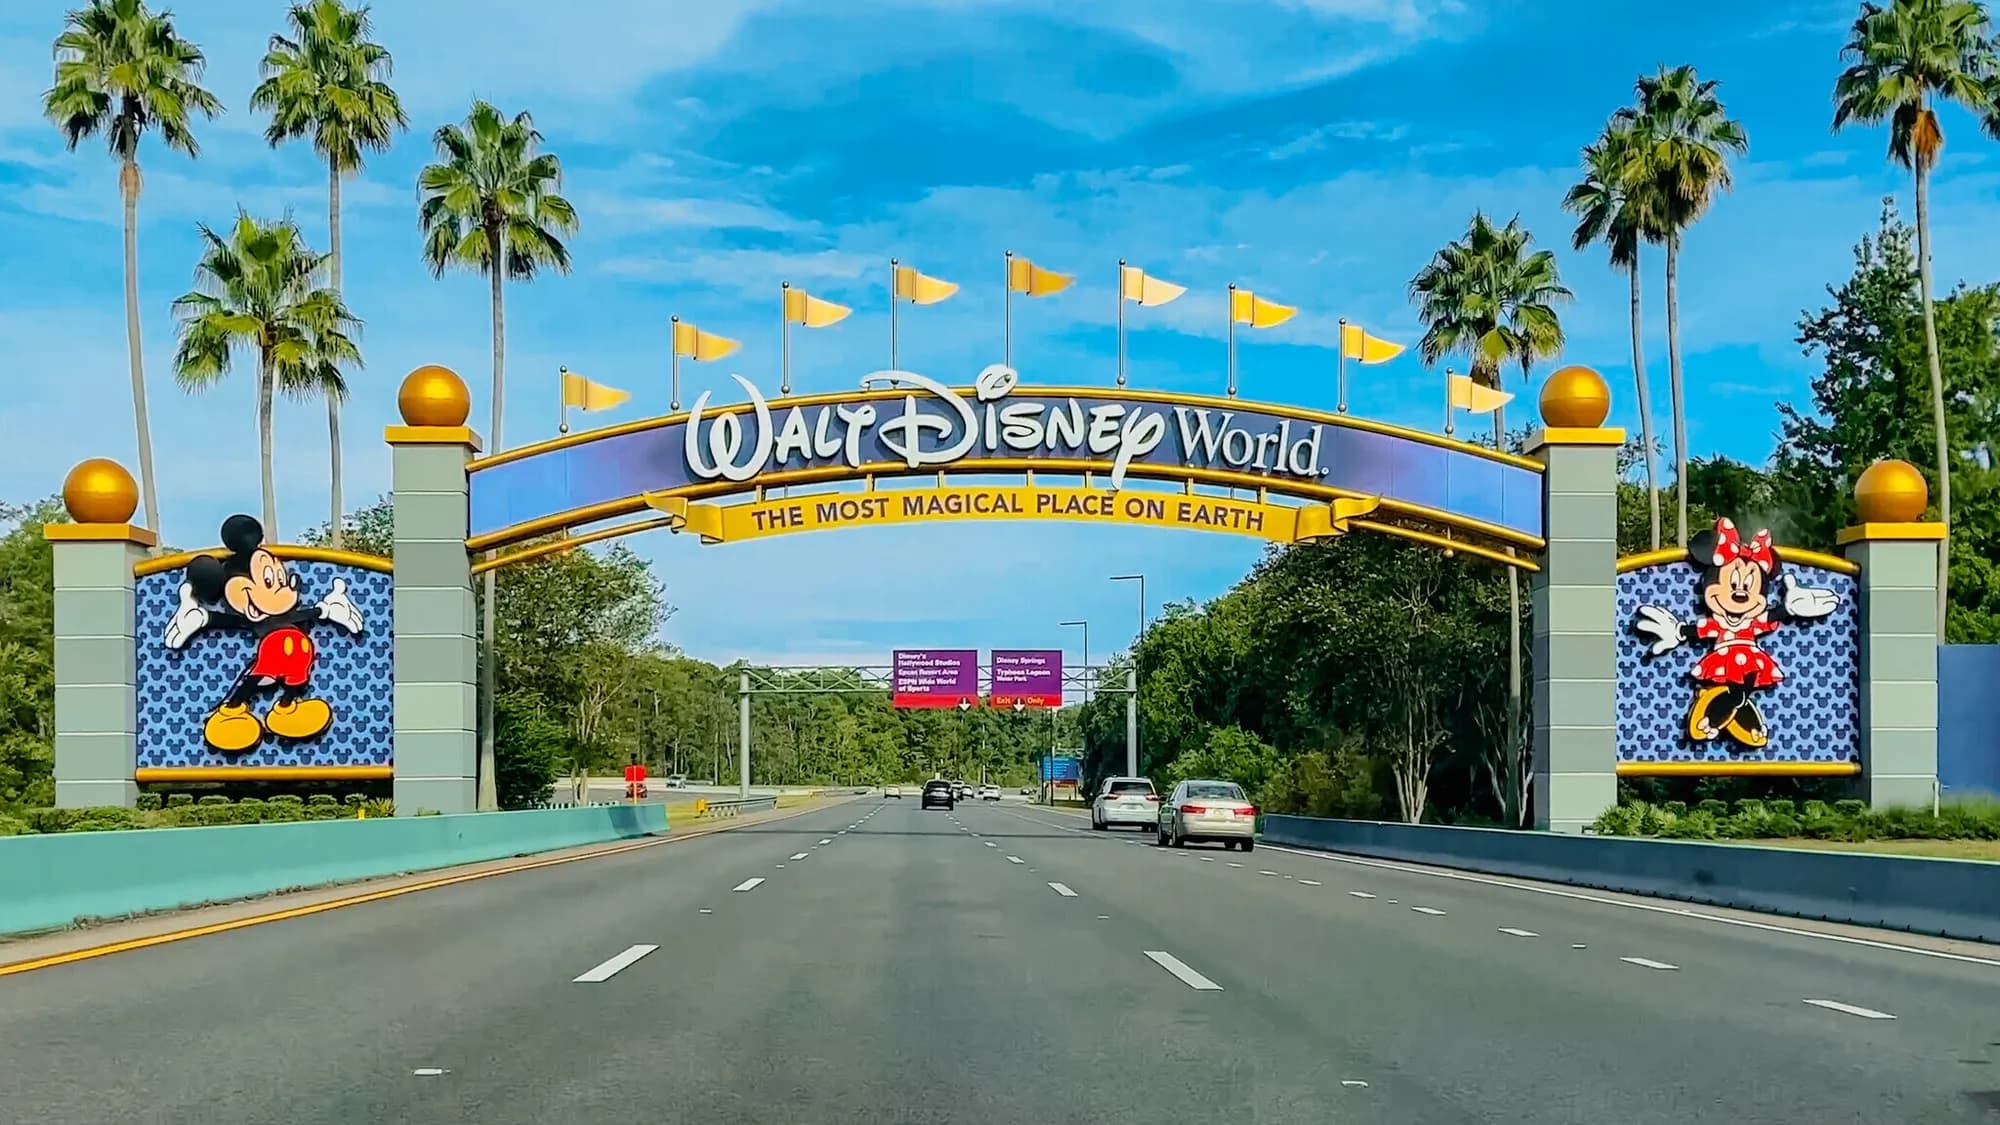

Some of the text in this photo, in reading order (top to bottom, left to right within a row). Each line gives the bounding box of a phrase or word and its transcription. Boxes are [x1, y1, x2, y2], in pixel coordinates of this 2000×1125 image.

[752, 492, 1265, 533] THE MOST MAGICAL PLACE ON EARTH
[996, 656, 1046, 665] Disney Springs
[996, 668, 1051, 677] Typhoon Lagoon
[907, 685, 930, 693] Sports
[996, 696, 1044, 705] Exit Only
